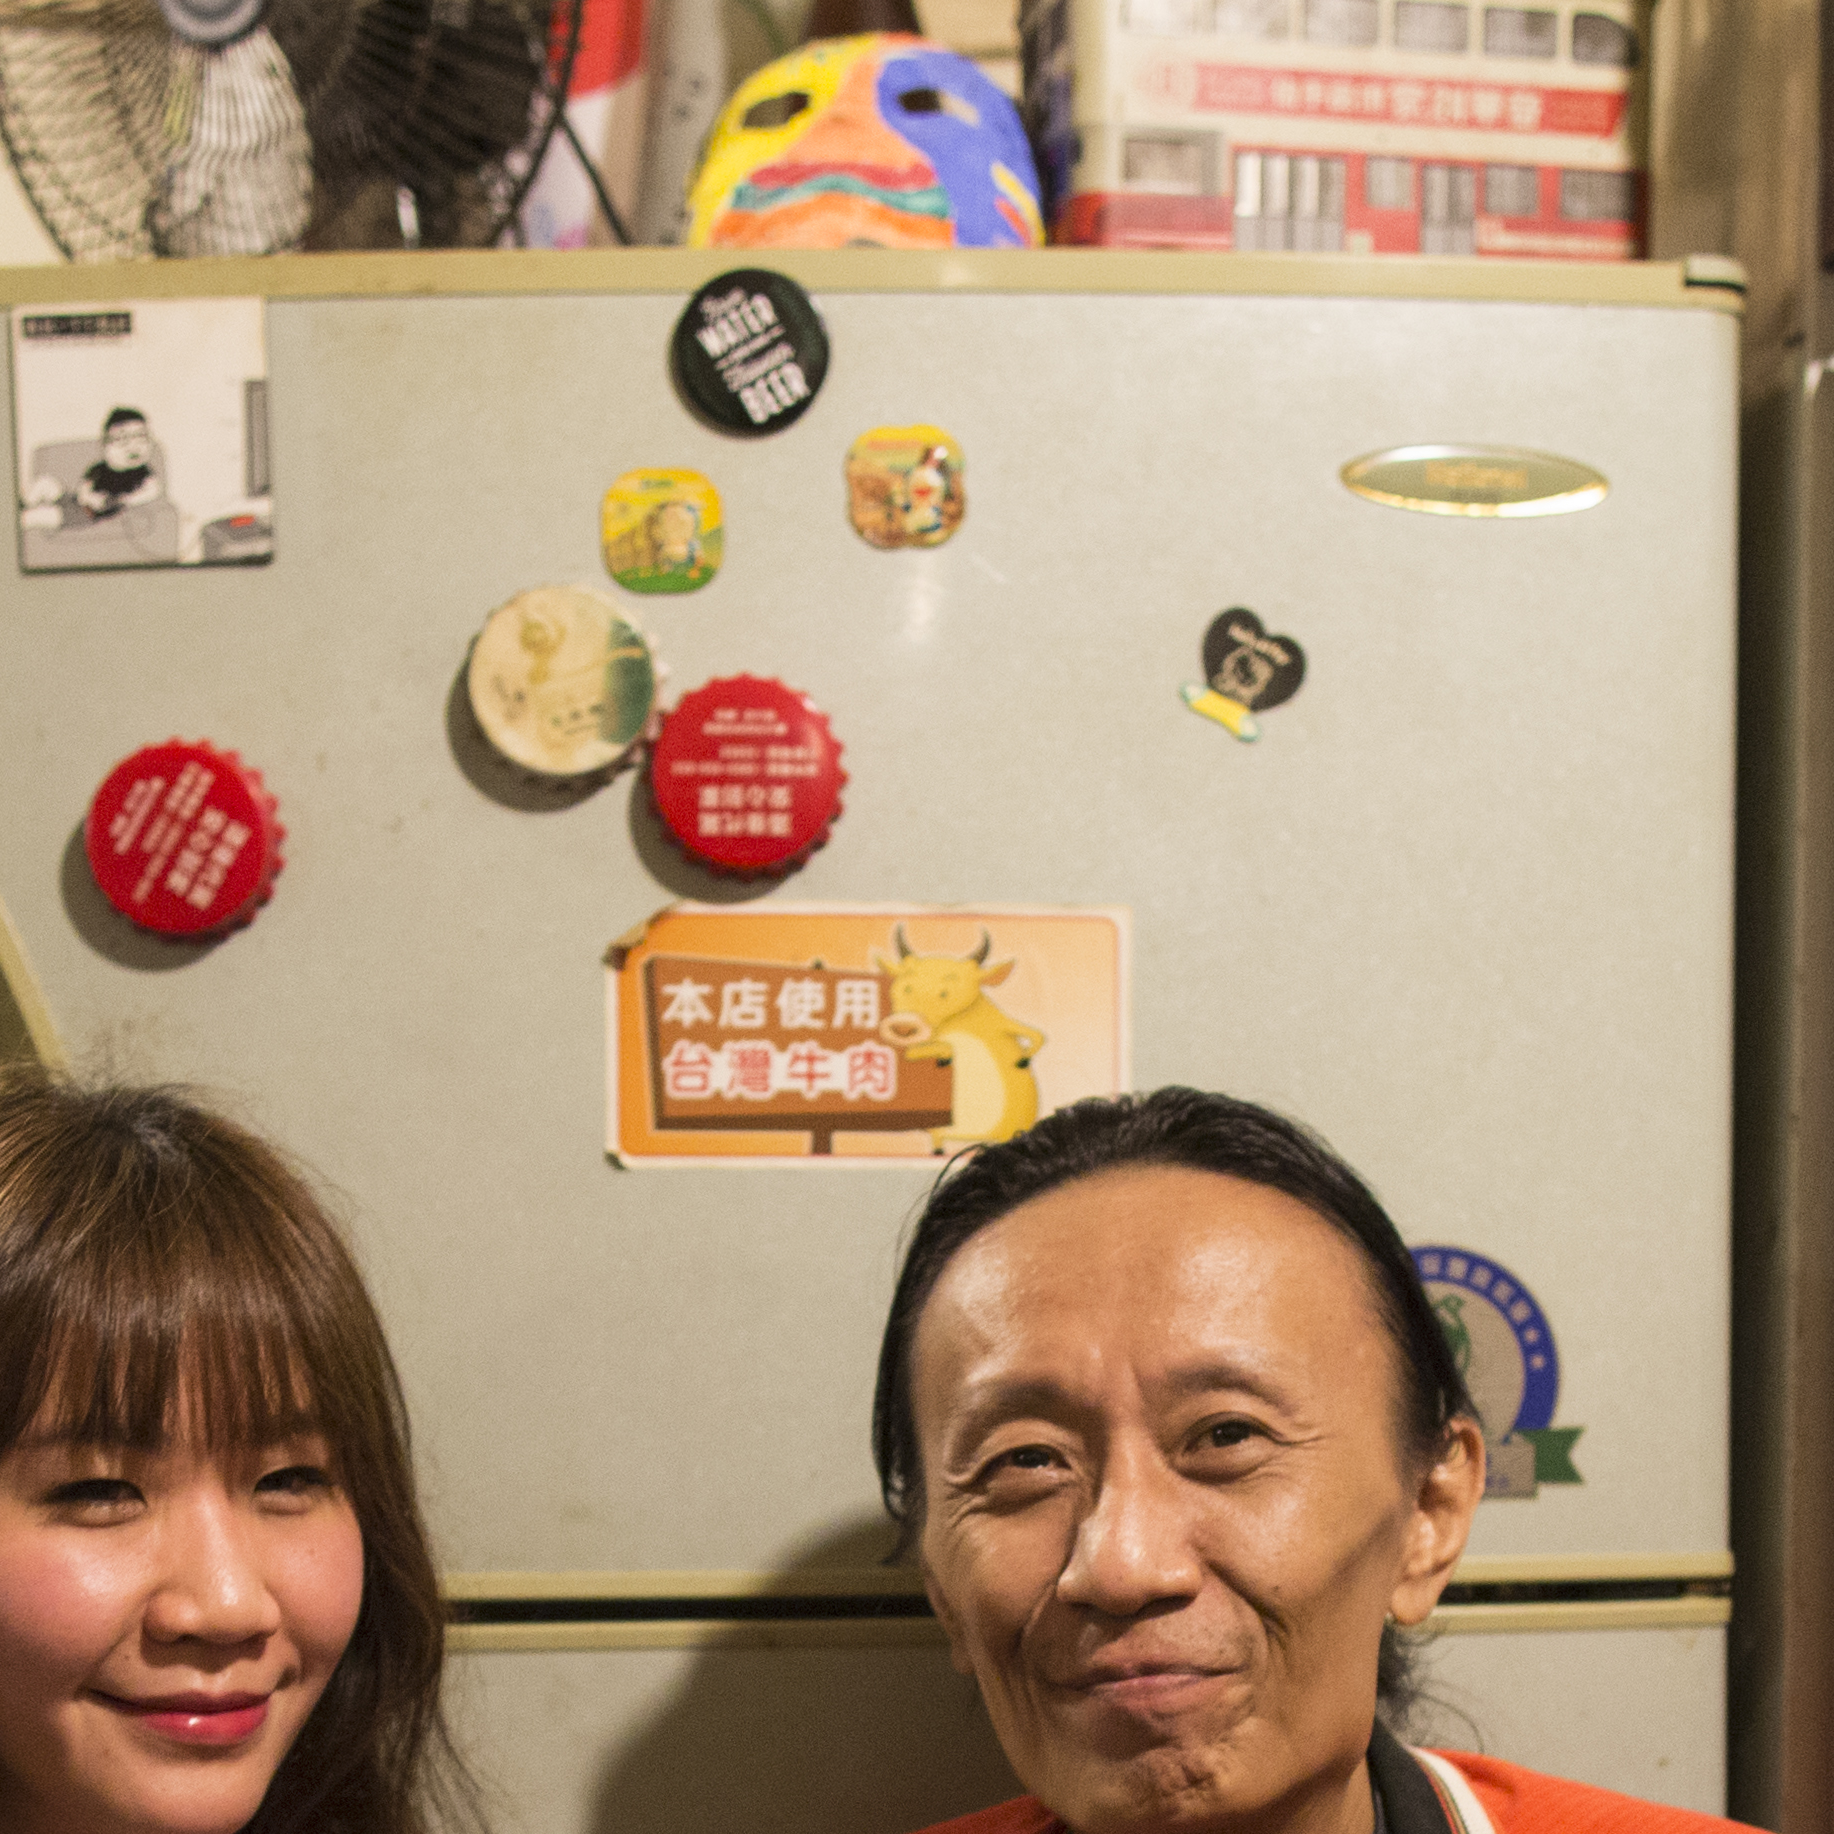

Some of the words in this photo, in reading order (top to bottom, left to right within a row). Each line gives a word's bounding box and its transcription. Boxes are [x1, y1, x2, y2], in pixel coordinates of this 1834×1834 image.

[695, 294, 779, 358] WATER
[739, 362, 811, 424] BEER
[660, 977, 882, 1029] 本店使用
[663, 1041, 898, 1100] 台灣牛肉
